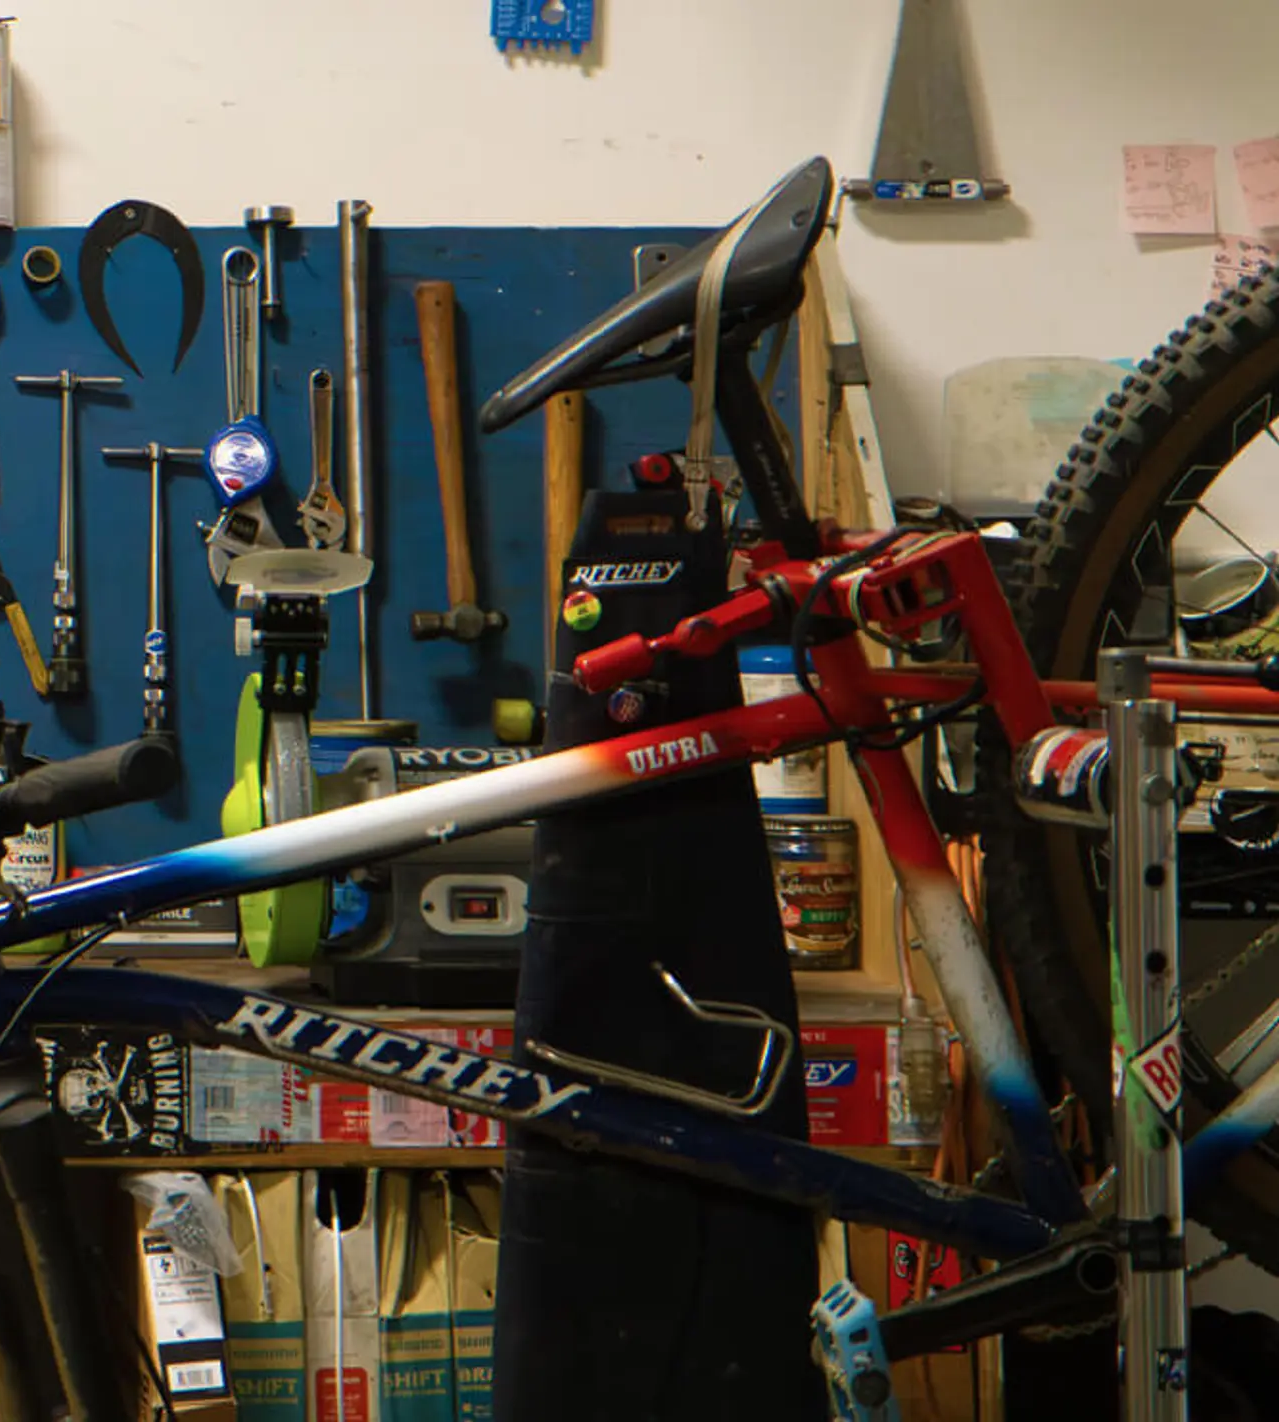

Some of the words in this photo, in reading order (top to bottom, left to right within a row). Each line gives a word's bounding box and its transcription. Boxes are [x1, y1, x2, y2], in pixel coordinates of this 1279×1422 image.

[570, 561, 683, 584] RITCHEY
[398, 748, 533, 767] RYOBI
[626, 731, 720, 775] ULTRA
[6, 851, 50, 865] Circus
[219, 996, 591, 1117] RITCHEY
[147, 1032, 183, 1152] BURNING
[234, 1377, 299, 1396] SHIFT
[383, 1368, 447, 1391] SHIFT
